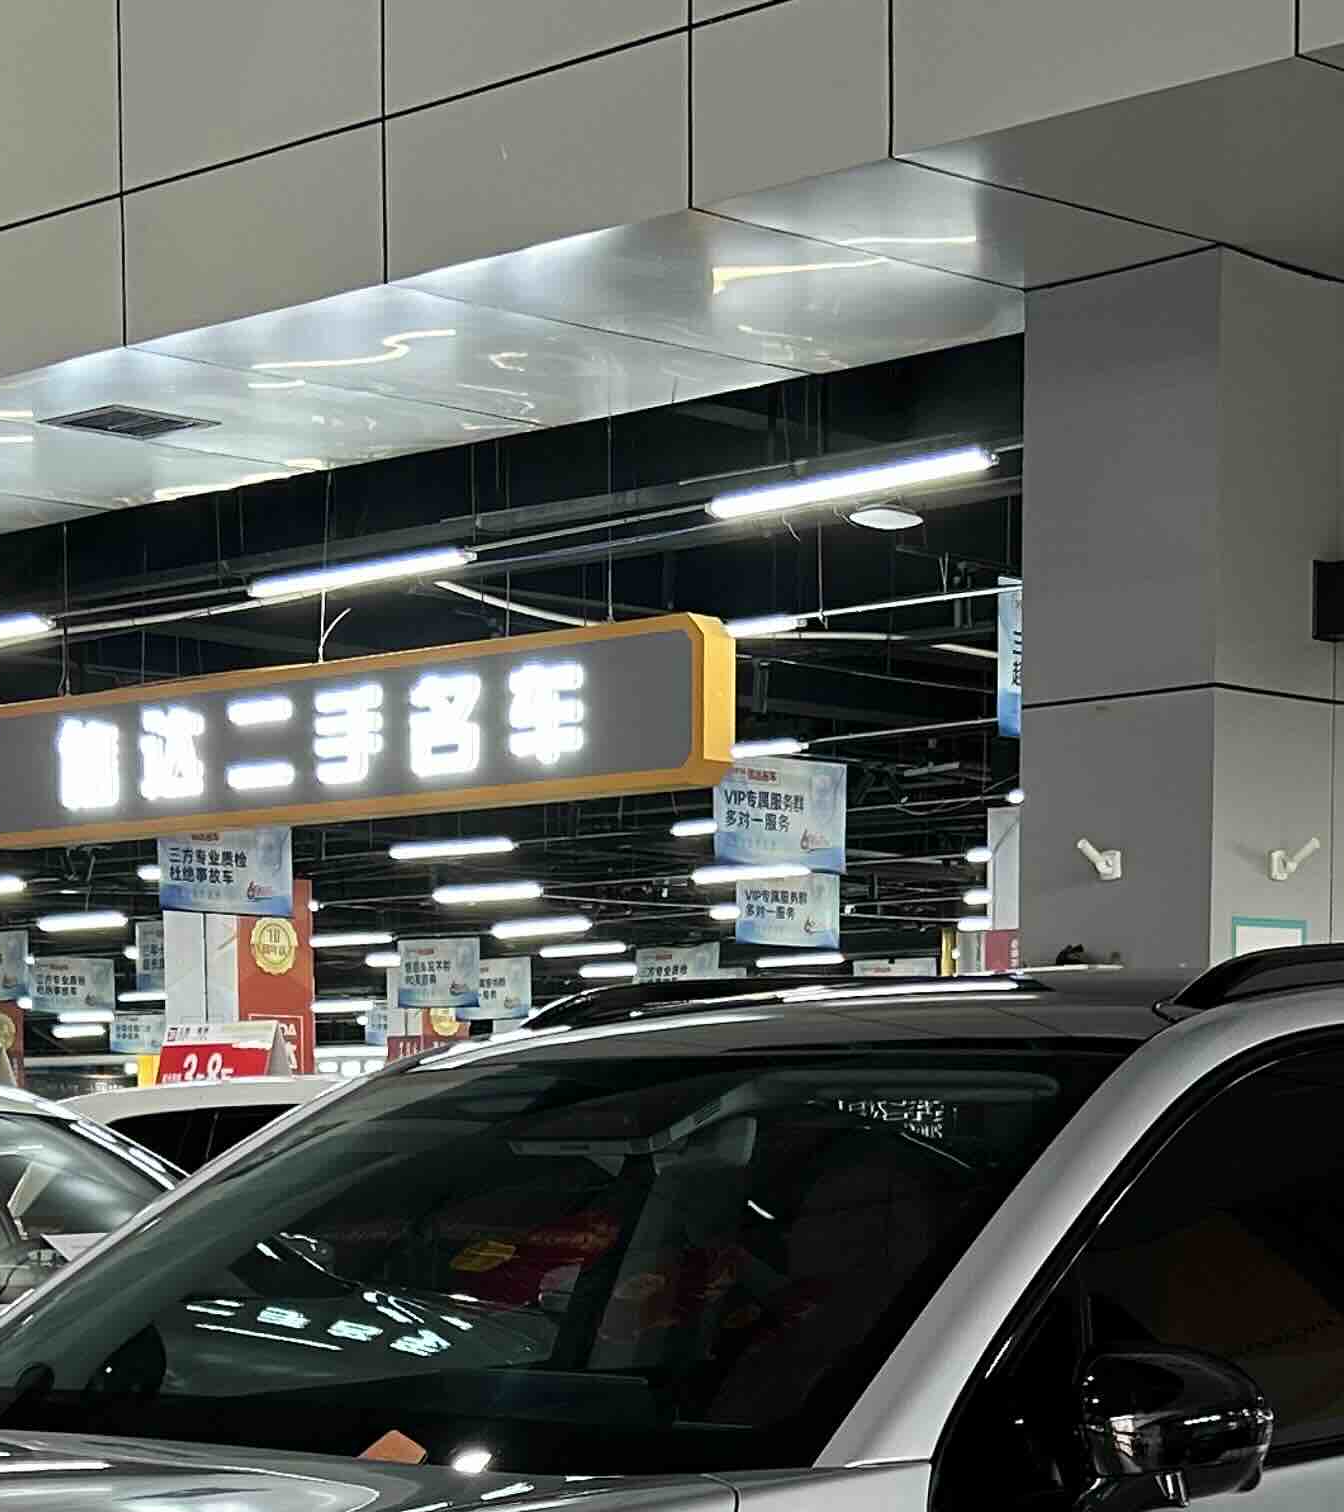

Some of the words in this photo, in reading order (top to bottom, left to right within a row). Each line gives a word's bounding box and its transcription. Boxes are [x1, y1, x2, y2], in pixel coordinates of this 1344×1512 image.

[723, 789, 804, 812] VIP专属服务群
[725, 809, 790, 833] 多对一服务
[168, 847, 248, 868] 三方专业质检
